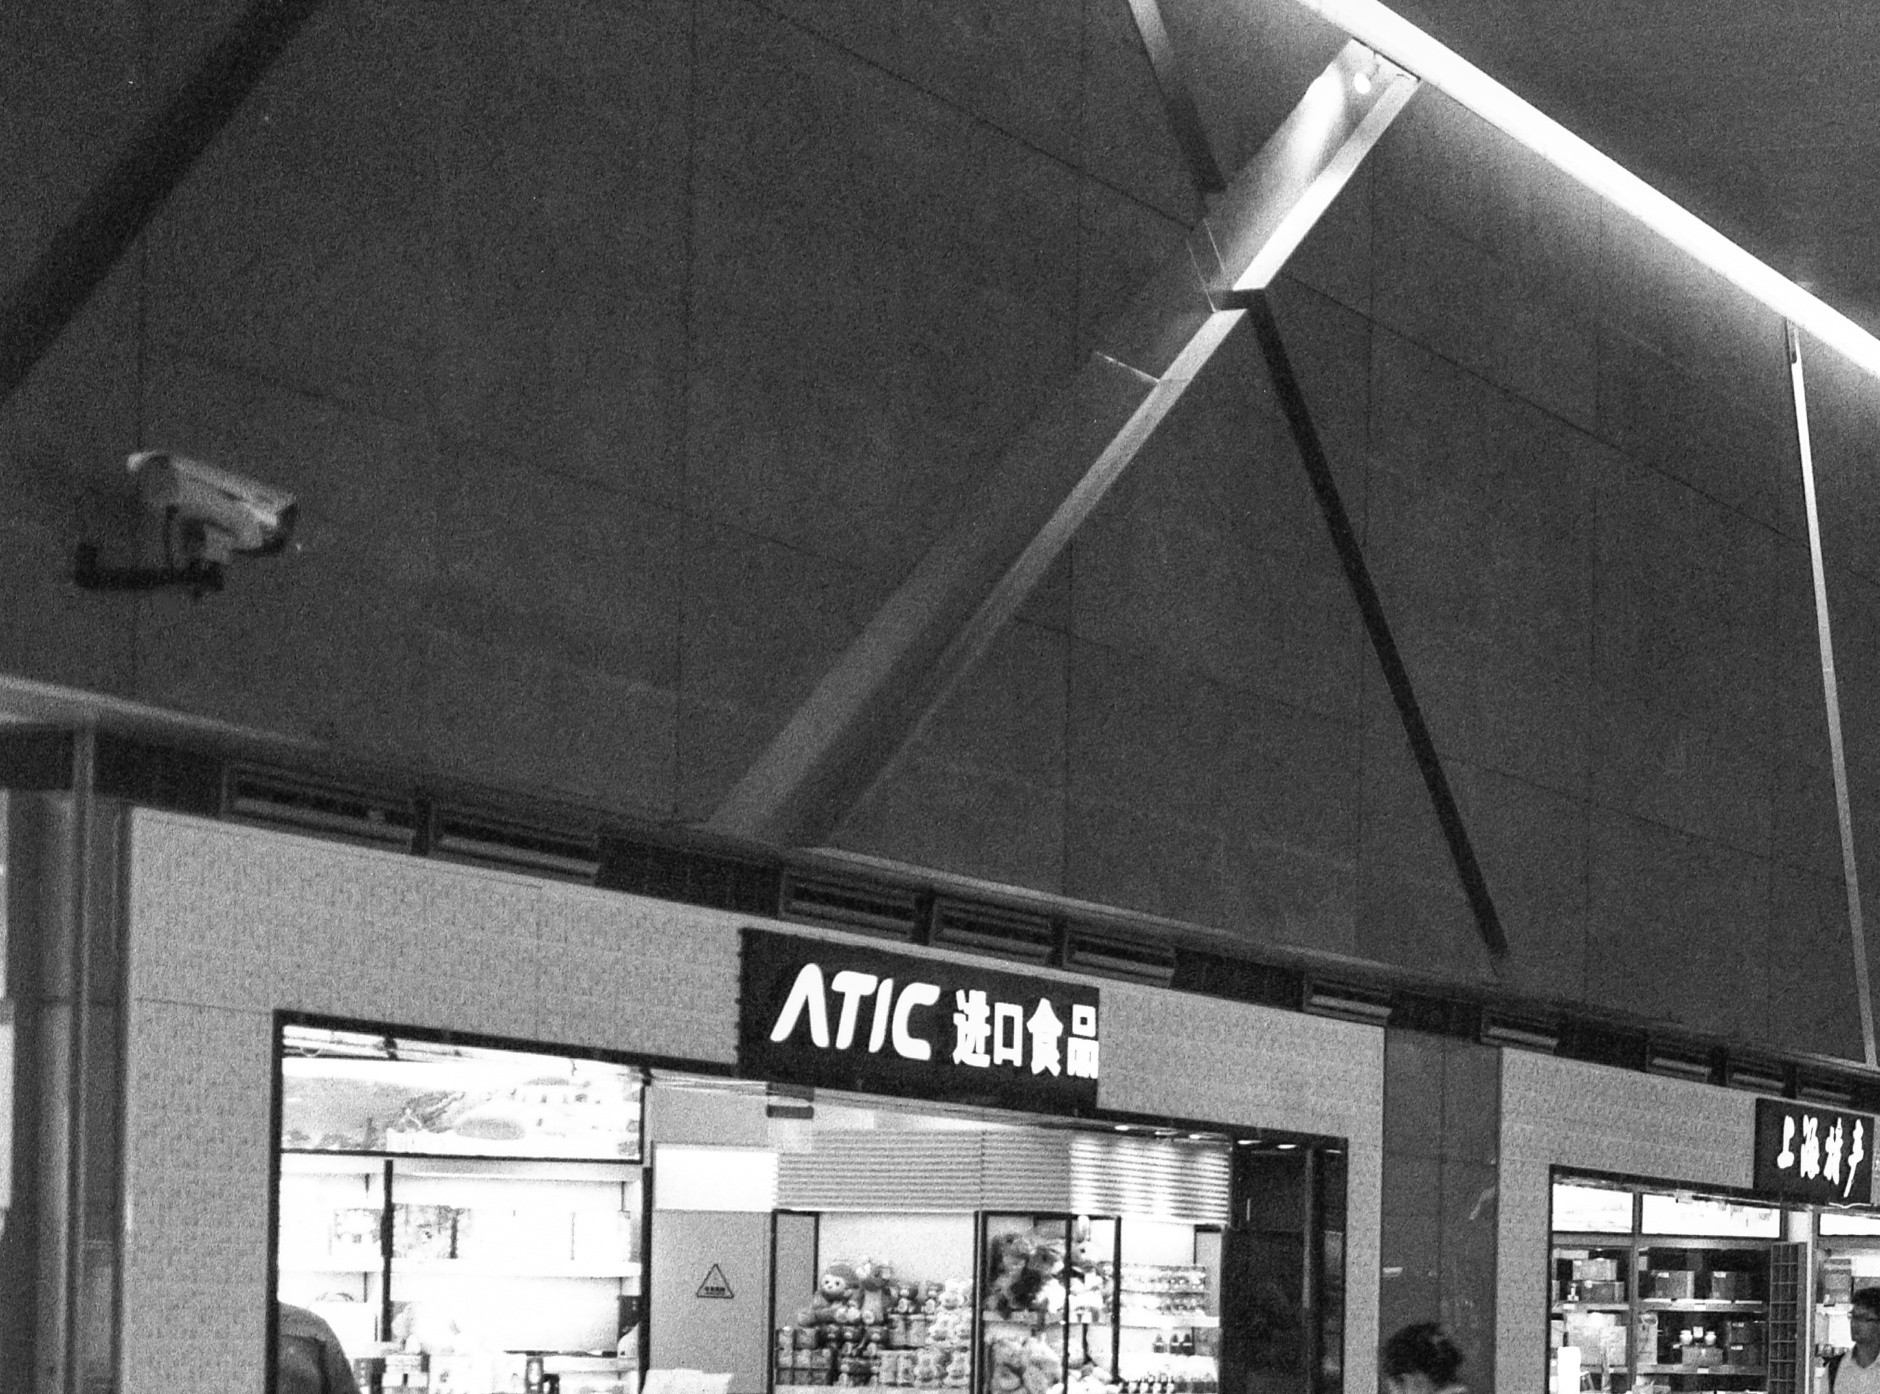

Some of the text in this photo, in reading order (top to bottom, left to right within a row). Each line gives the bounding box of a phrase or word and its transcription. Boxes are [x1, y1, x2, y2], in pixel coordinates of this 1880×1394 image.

[769, 962, 1099, 1079] ATIC 进口食品
